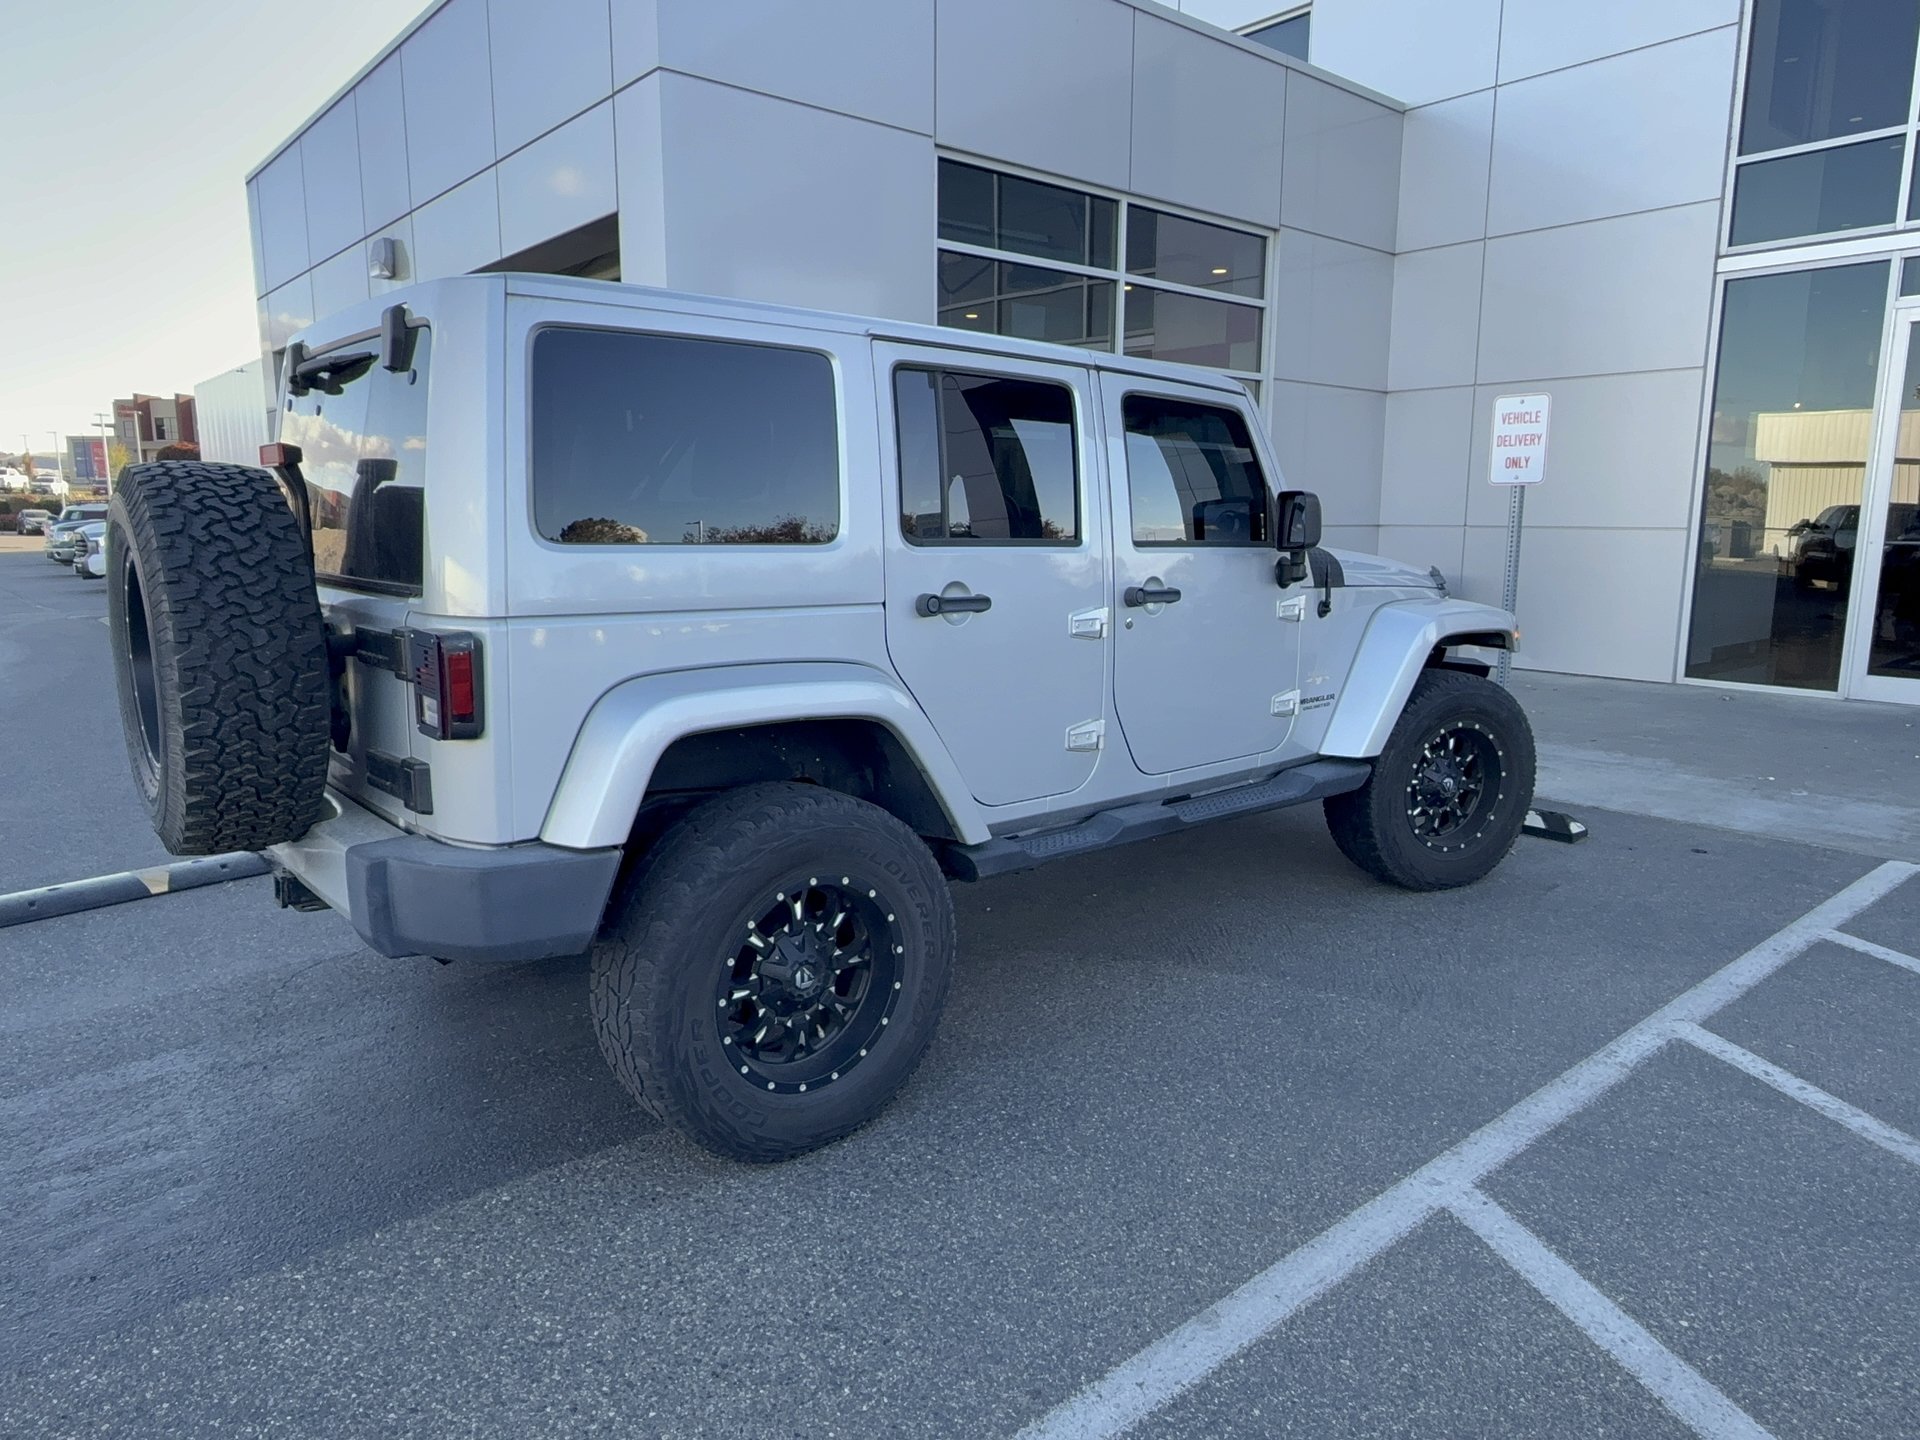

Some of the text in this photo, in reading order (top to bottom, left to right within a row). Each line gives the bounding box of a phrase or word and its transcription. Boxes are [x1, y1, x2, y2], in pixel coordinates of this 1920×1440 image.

[1501, 410, 1541, 425] VEHICLE
[1496, 433, 1543, 448] DELIVERY
[1504, 456, 1530, 469] ONLY
[1300, 693, 1335, 705] WRANGLER
[689, 1018, 768, 1129] COOPER
